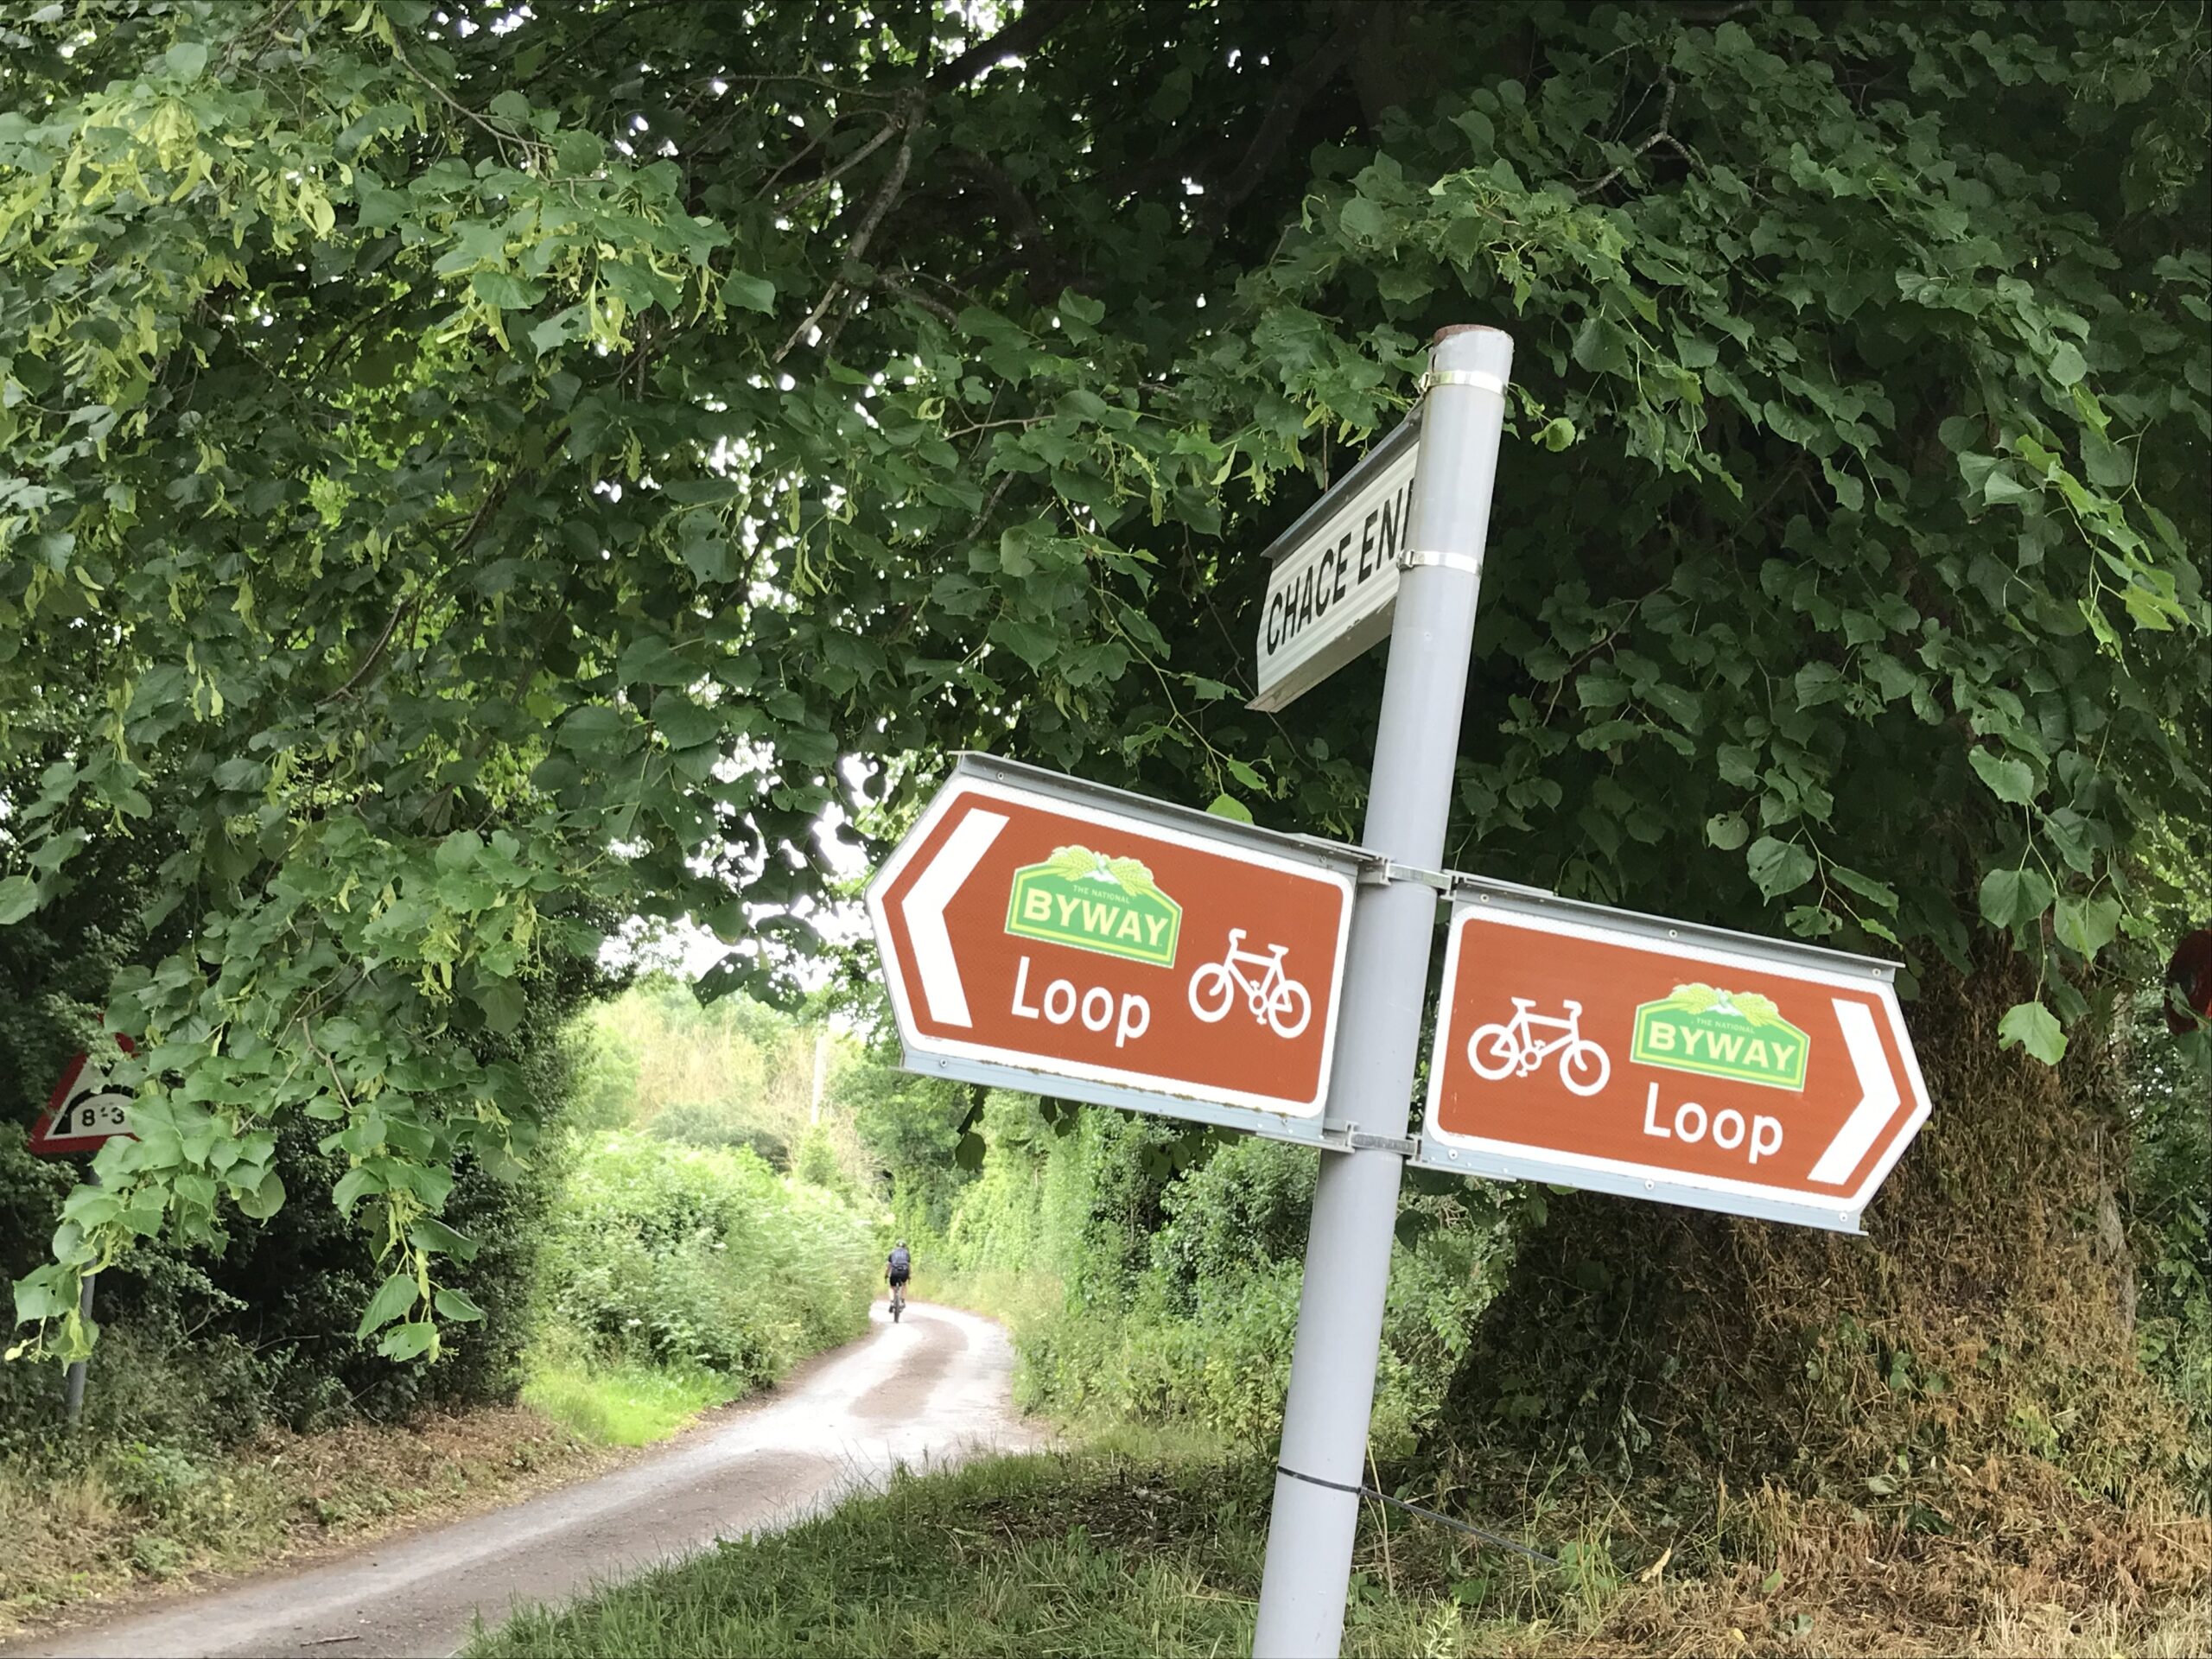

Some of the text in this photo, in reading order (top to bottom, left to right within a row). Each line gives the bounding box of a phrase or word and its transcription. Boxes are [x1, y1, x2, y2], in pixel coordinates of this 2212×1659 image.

[1267, 531, 1351, 655] CHACE
[1023, 887, 1168, 947] BYWAY
[1073, 885, 1130, 904] THE NATIONAL
[1011, 956, 1151, 1048] Loop
[1696, 1017, 1755, 1034] THE NATIONAL
[1648, 1020, 1796, 1071] BYWAY
[1643, 1082, 1783, 1164] Loop
